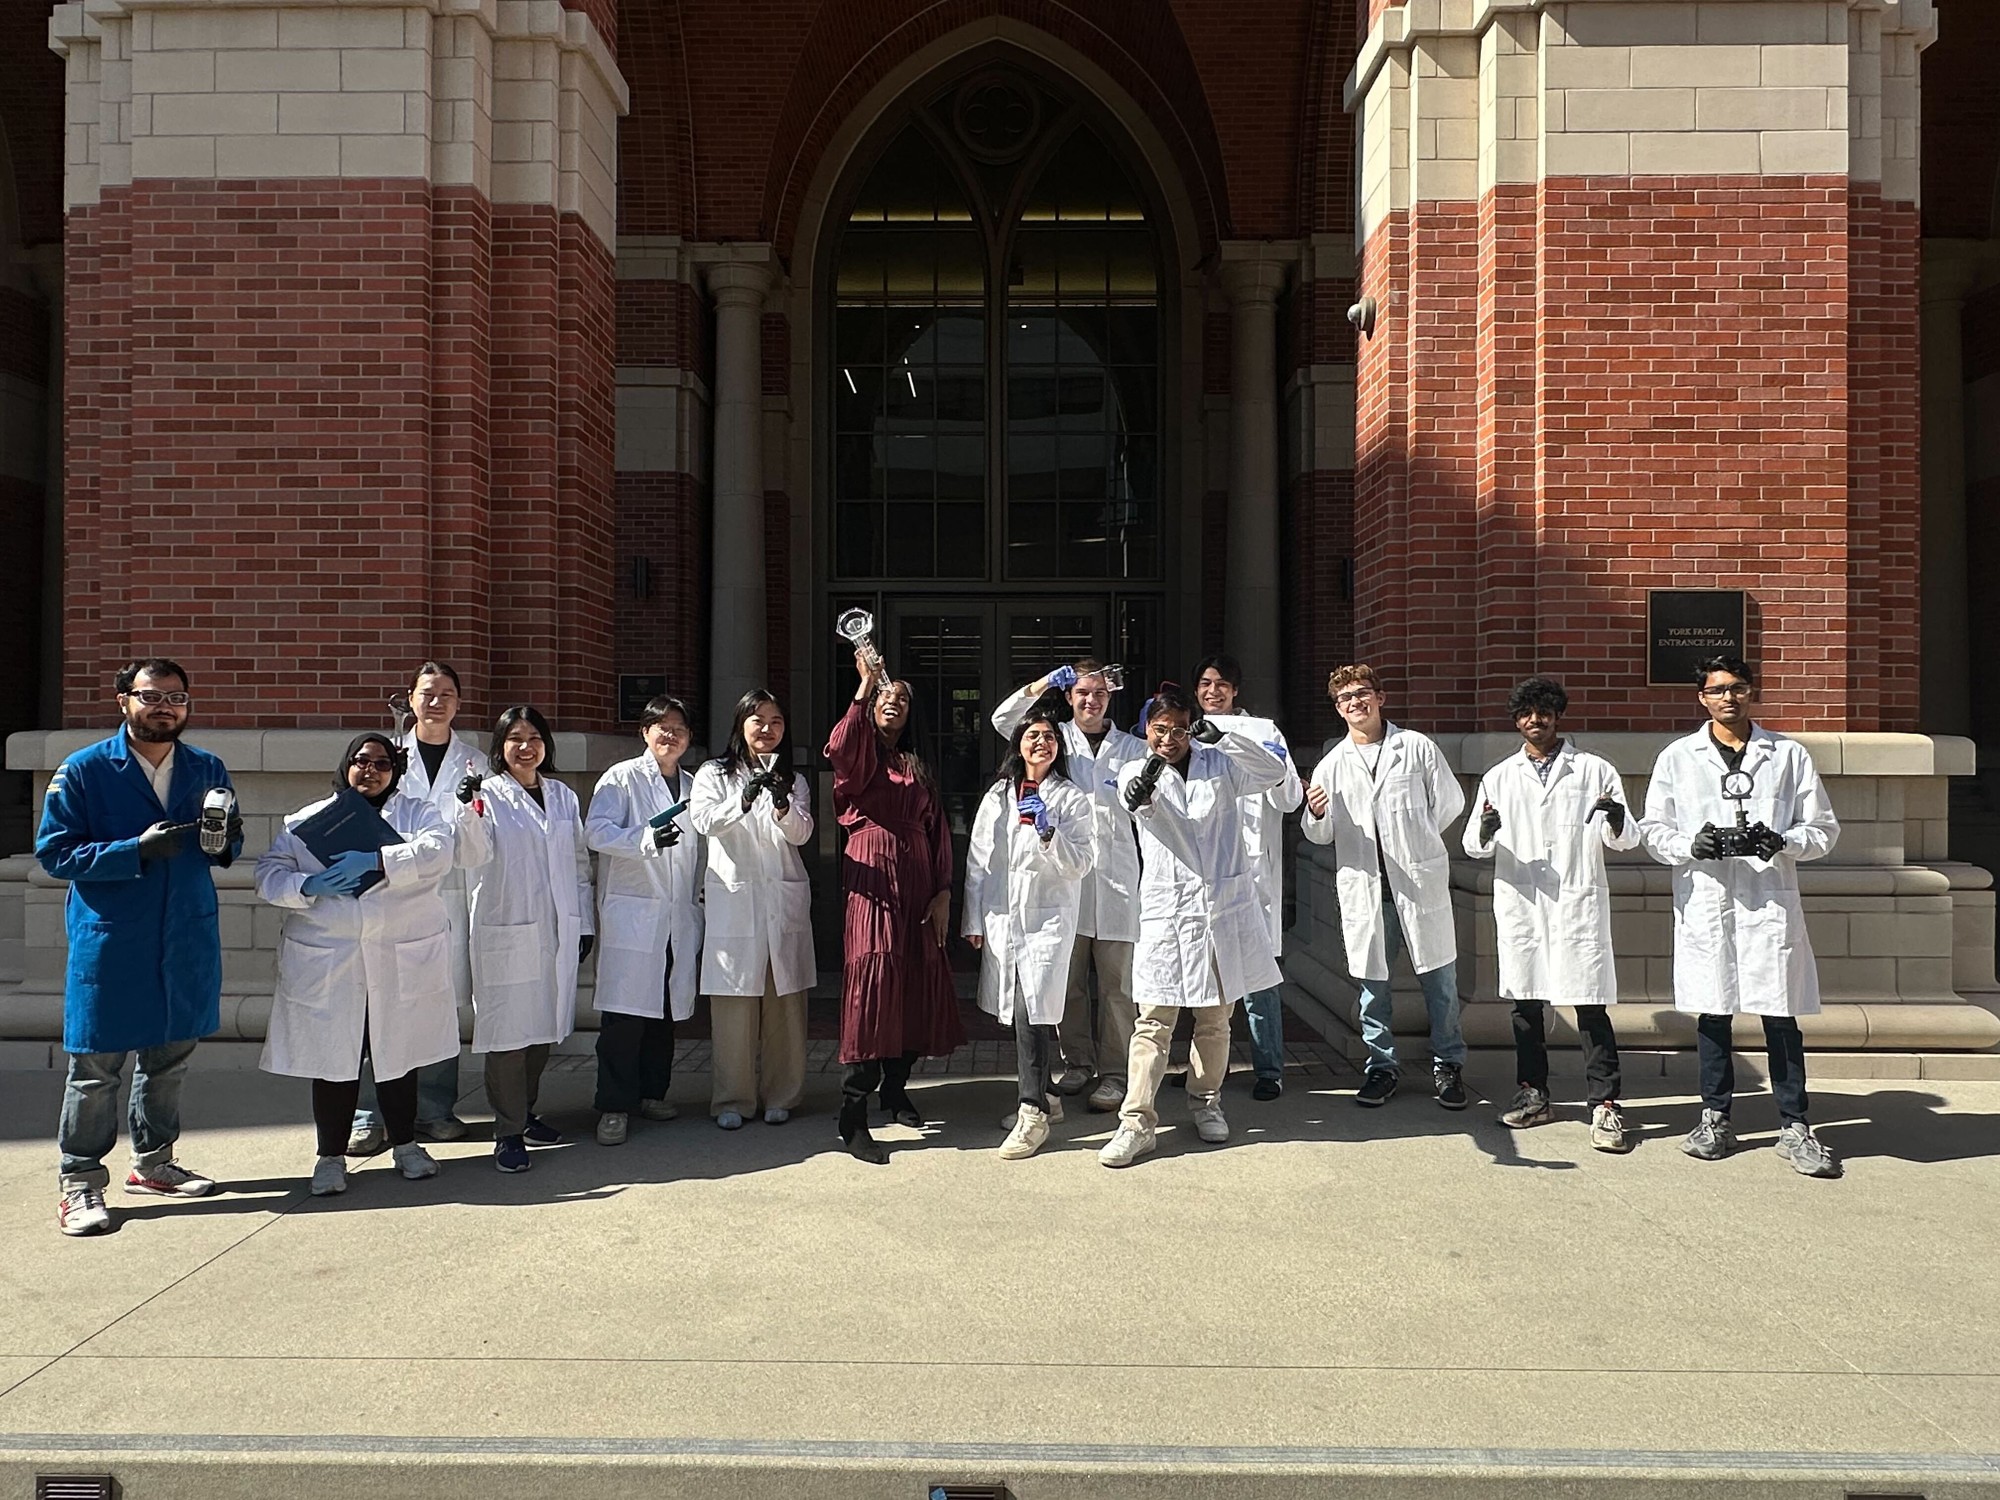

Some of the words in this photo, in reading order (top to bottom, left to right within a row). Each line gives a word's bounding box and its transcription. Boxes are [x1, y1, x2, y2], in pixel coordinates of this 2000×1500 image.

[1668, 628, 1691, 636] YORK
[1693, 628, 1725, 636] FAMILY
[1658, 638, 1705, 647] ENTRANCE
[1706, 638, 1735, 647] PLAZA
